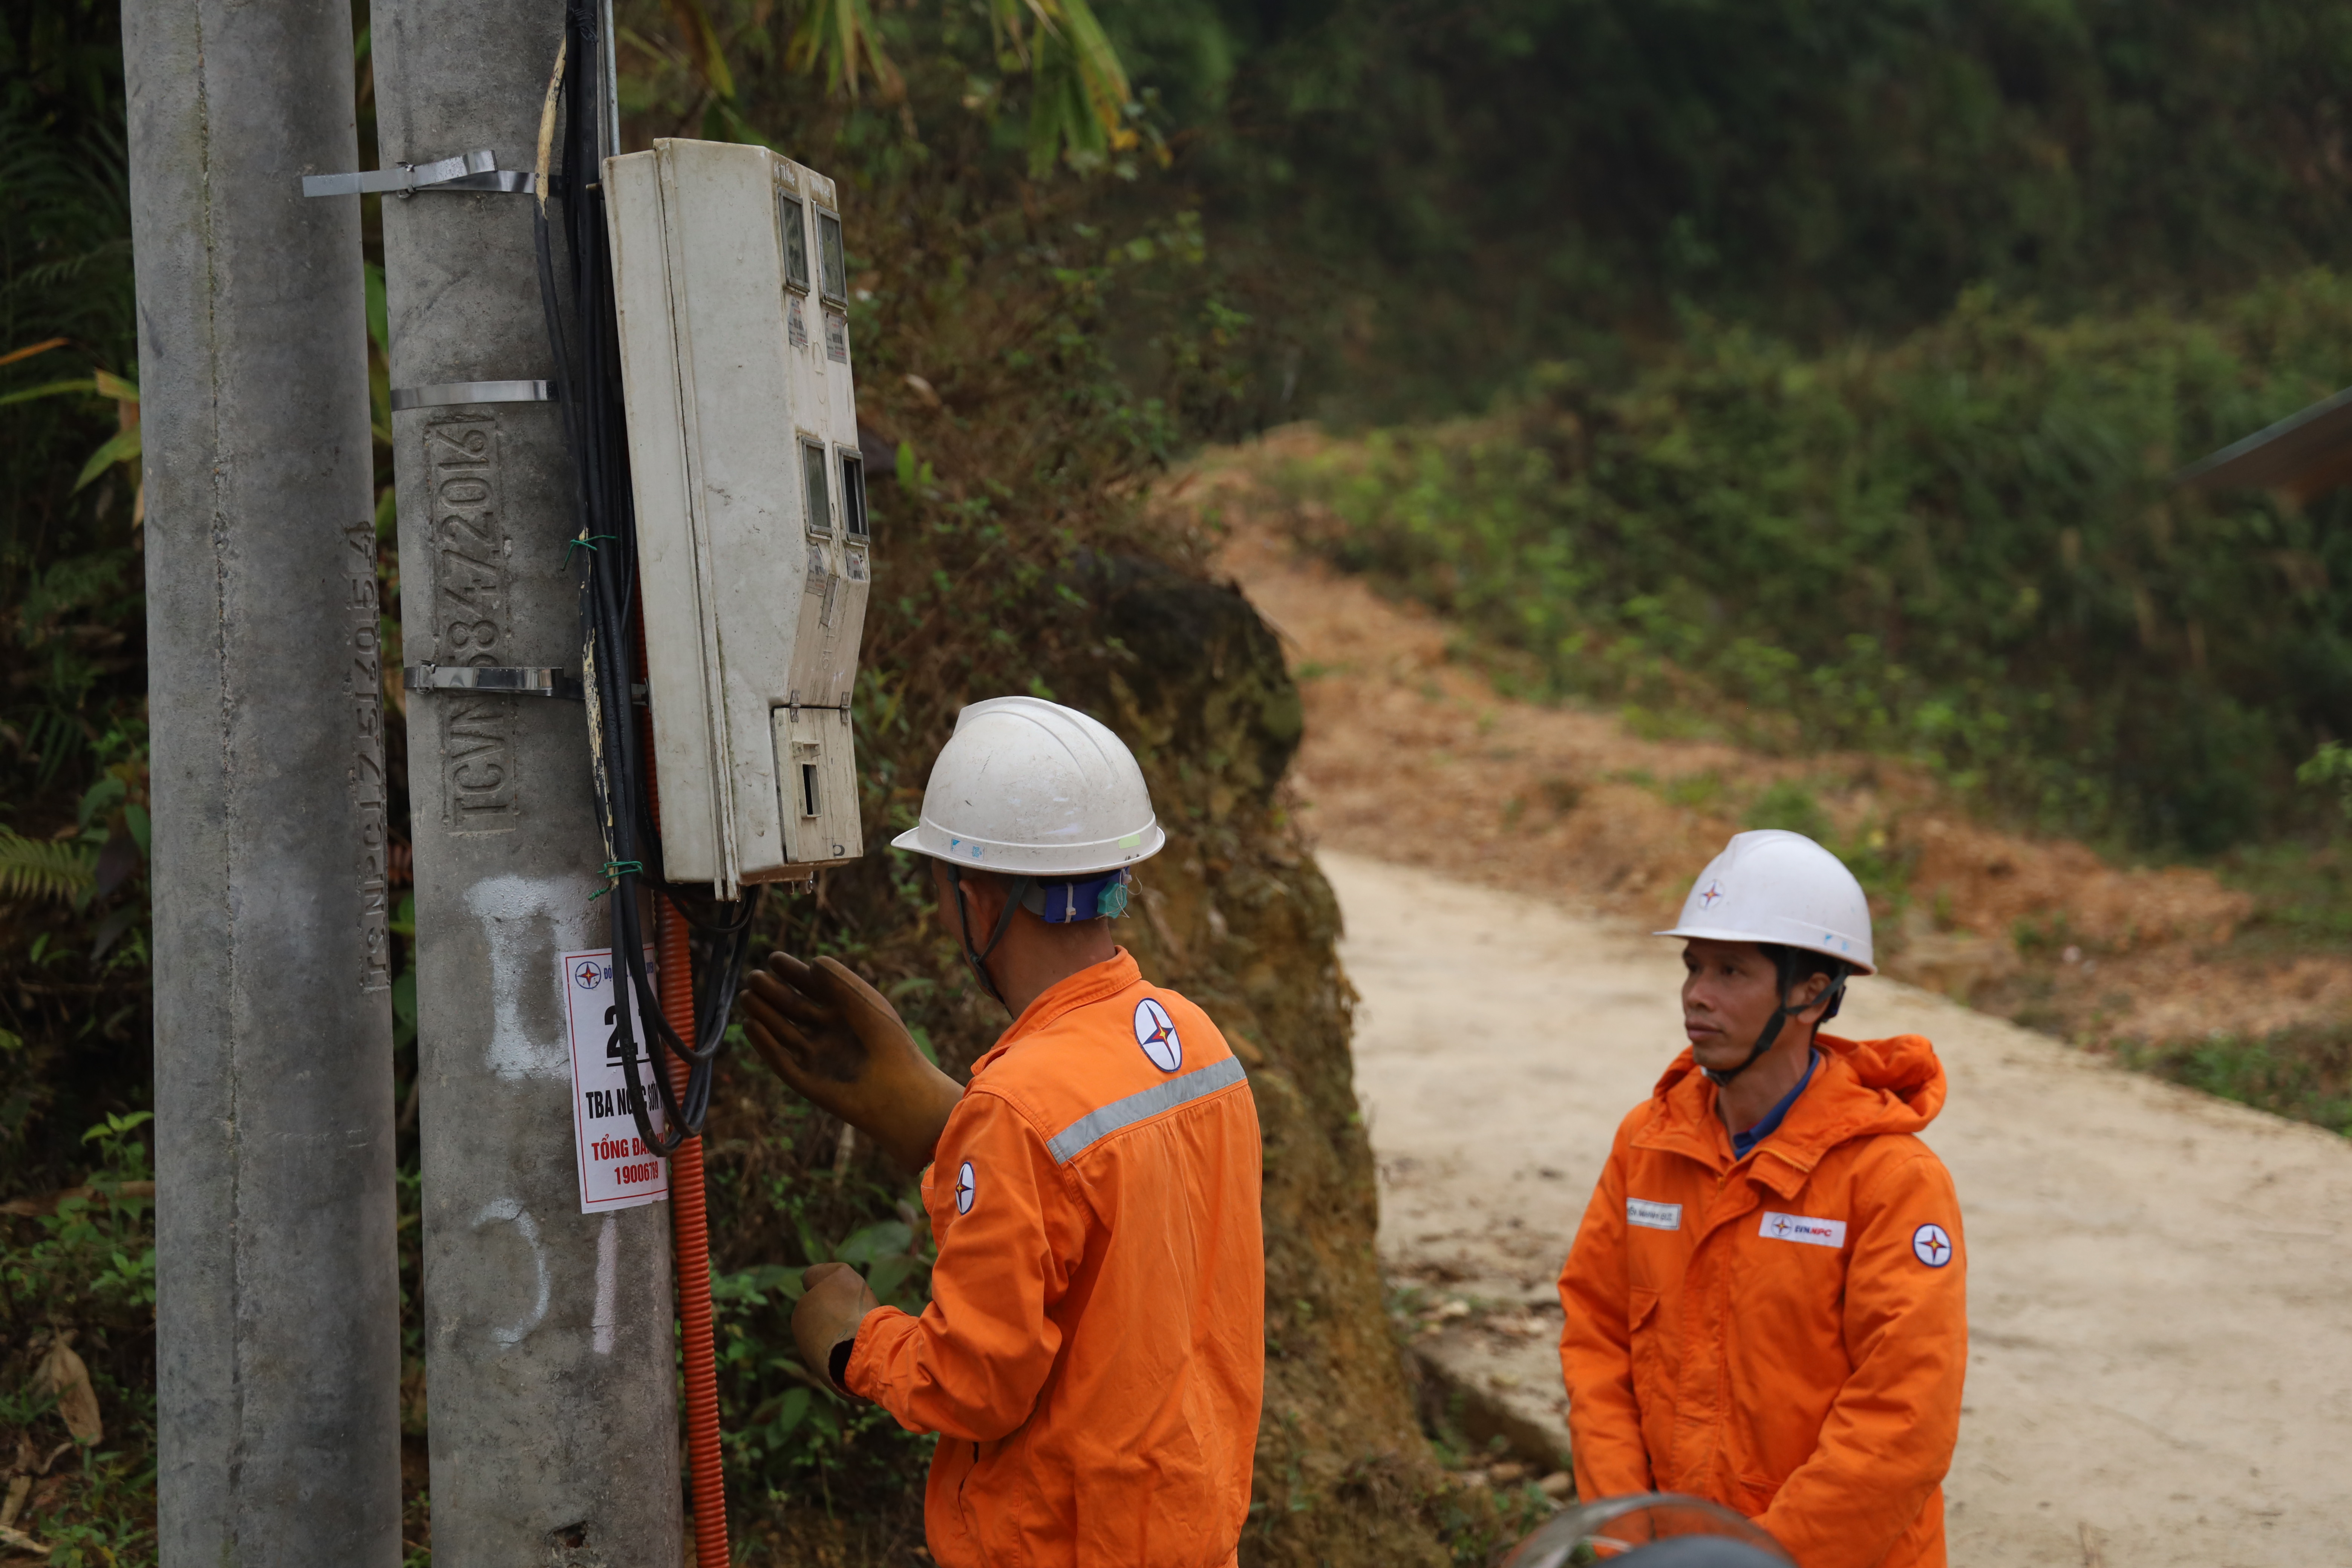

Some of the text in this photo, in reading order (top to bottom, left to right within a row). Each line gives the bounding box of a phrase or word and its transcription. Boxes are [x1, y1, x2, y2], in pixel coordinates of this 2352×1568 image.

[585, 1090, 614, 1119] TBA
[591, 1133, 629, 1161] TỔNG
[614, 1161, 658, 1185] 19006769
